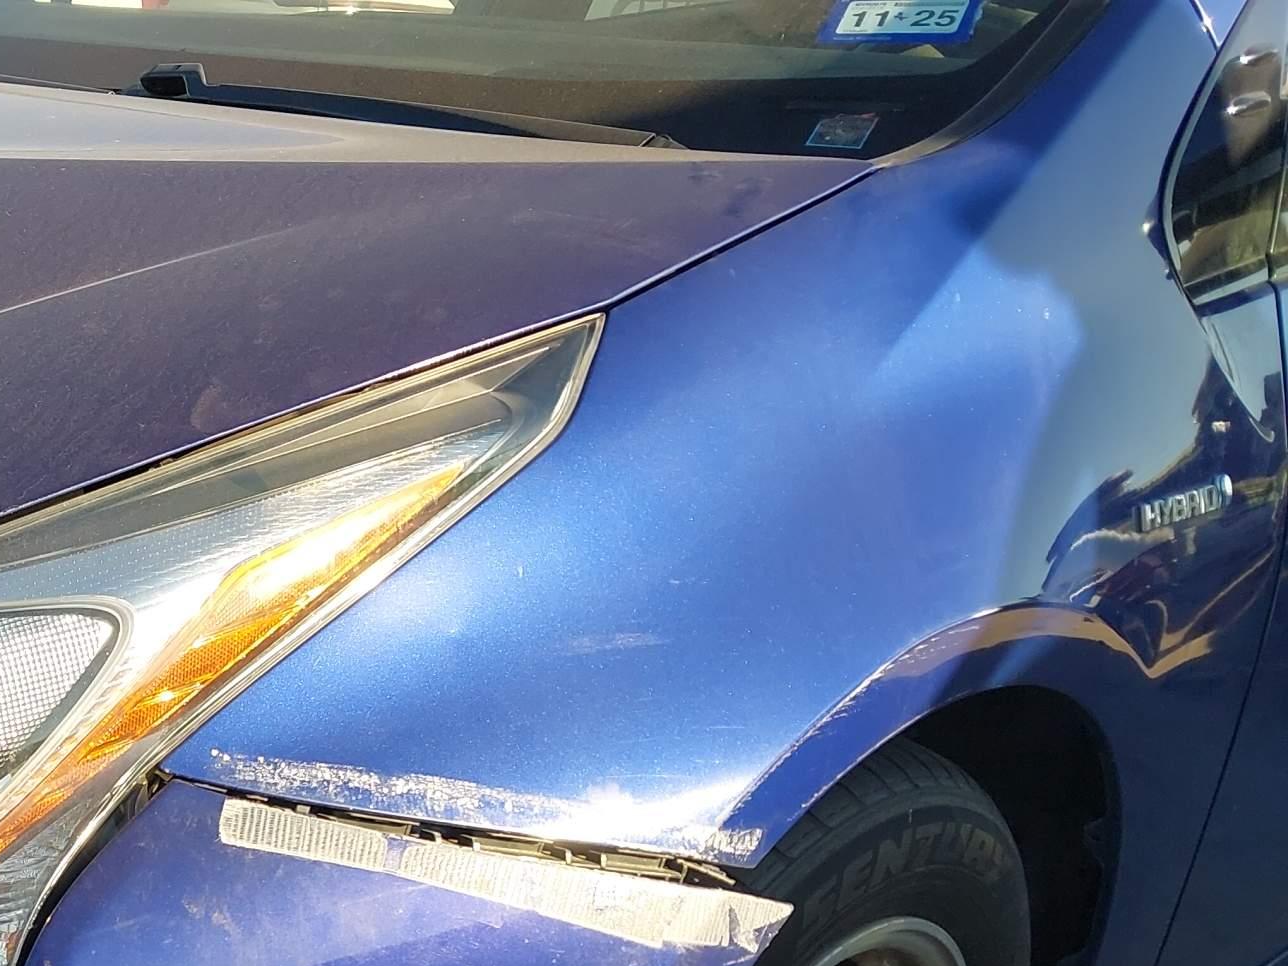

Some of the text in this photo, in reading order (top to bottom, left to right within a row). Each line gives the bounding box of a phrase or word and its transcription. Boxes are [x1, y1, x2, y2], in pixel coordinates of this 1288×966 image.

[852, 10, 959, 27] 11 25
[1141, 484, 1219, 532] HYBRID
